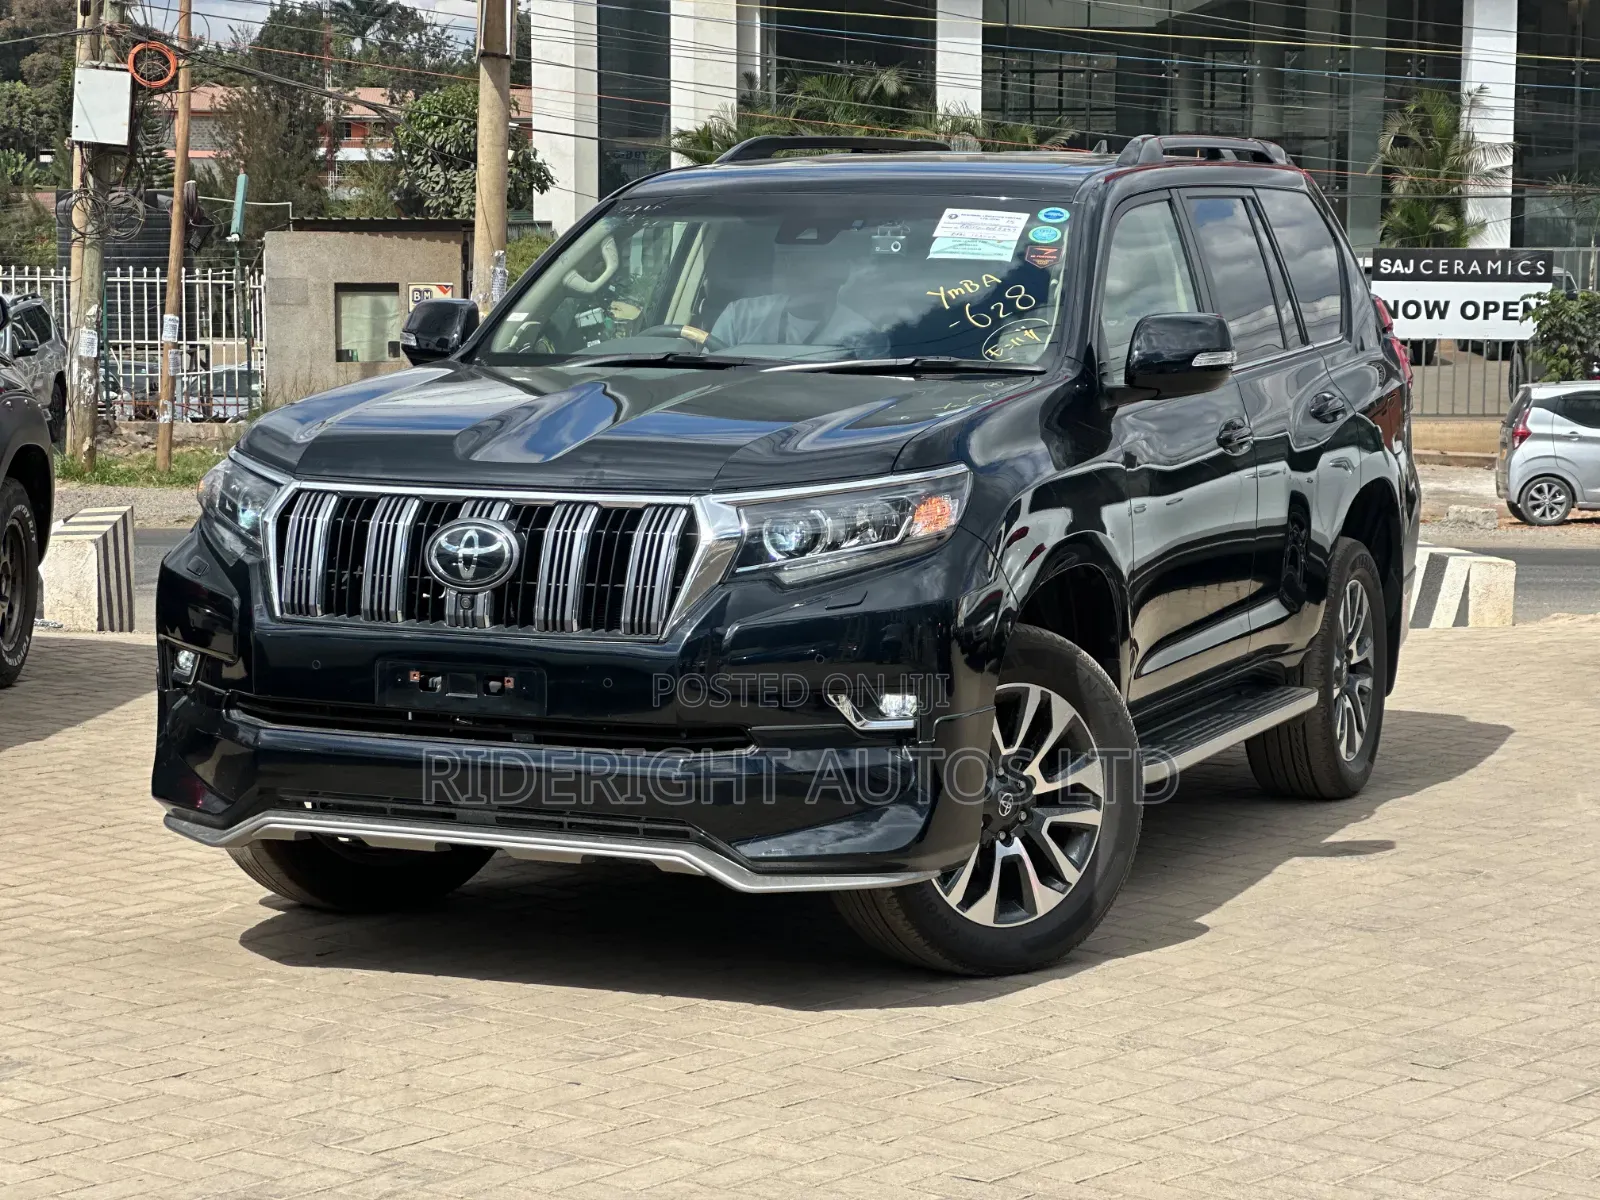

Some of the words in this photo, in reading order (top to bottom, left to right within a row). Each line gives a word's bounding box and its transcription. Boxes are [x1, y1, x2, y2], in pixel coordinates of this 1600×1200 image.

[1379, 258, 1415, 274] SAJ
[1419, 259, 1546, 276] CERAMICS
[1382, 299, 1451, 320] NOW
